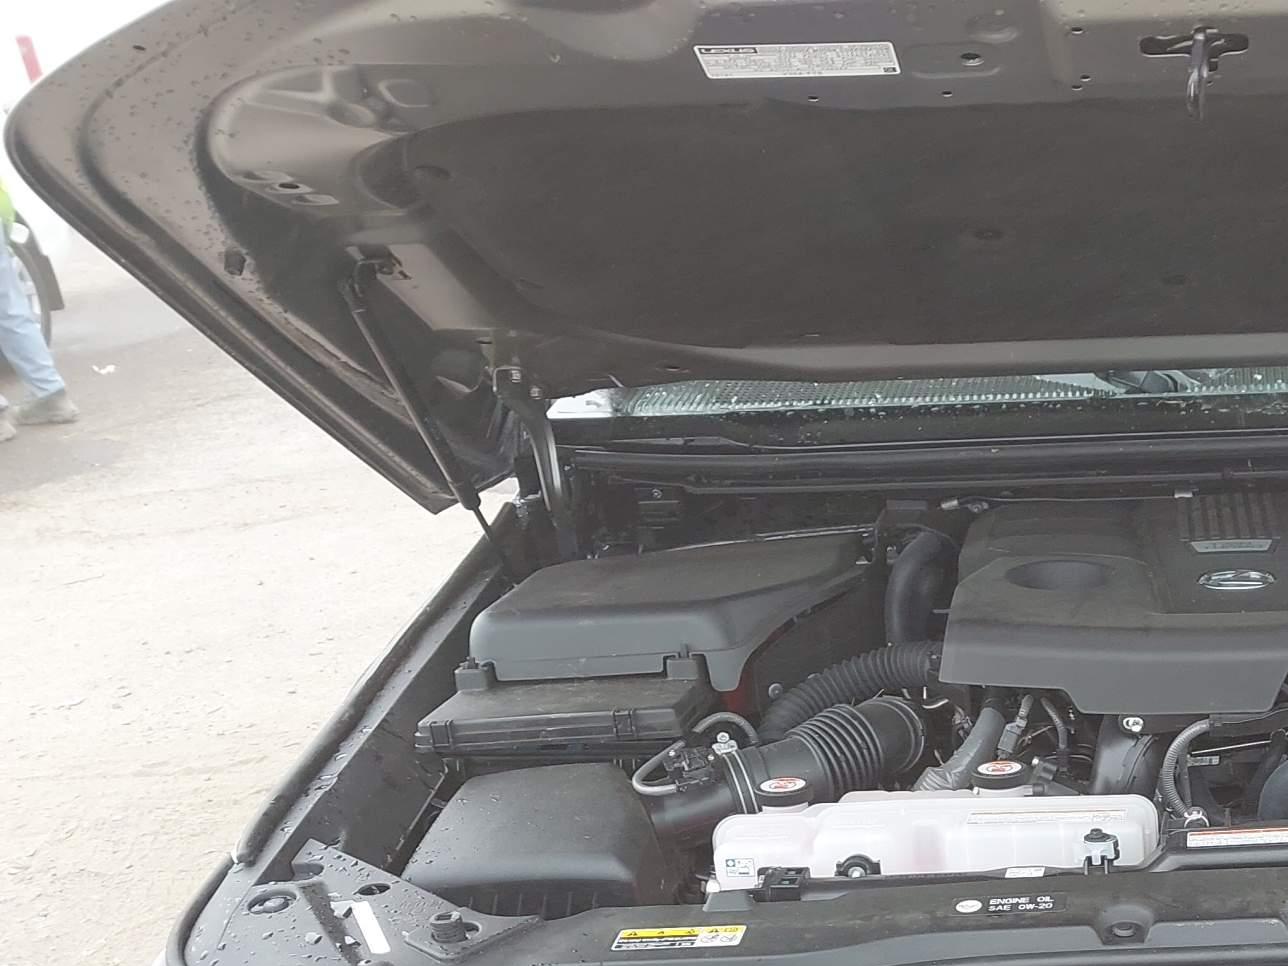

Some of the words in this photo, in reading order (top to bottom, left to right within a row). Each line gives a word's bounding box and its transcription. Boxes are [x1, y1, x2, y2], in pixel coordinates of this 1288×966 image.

[989, 896, 1031, 905] ENGINE
[1036, 895, 1055, 903] OIL
[987, 904, 1012, 912] SAE
